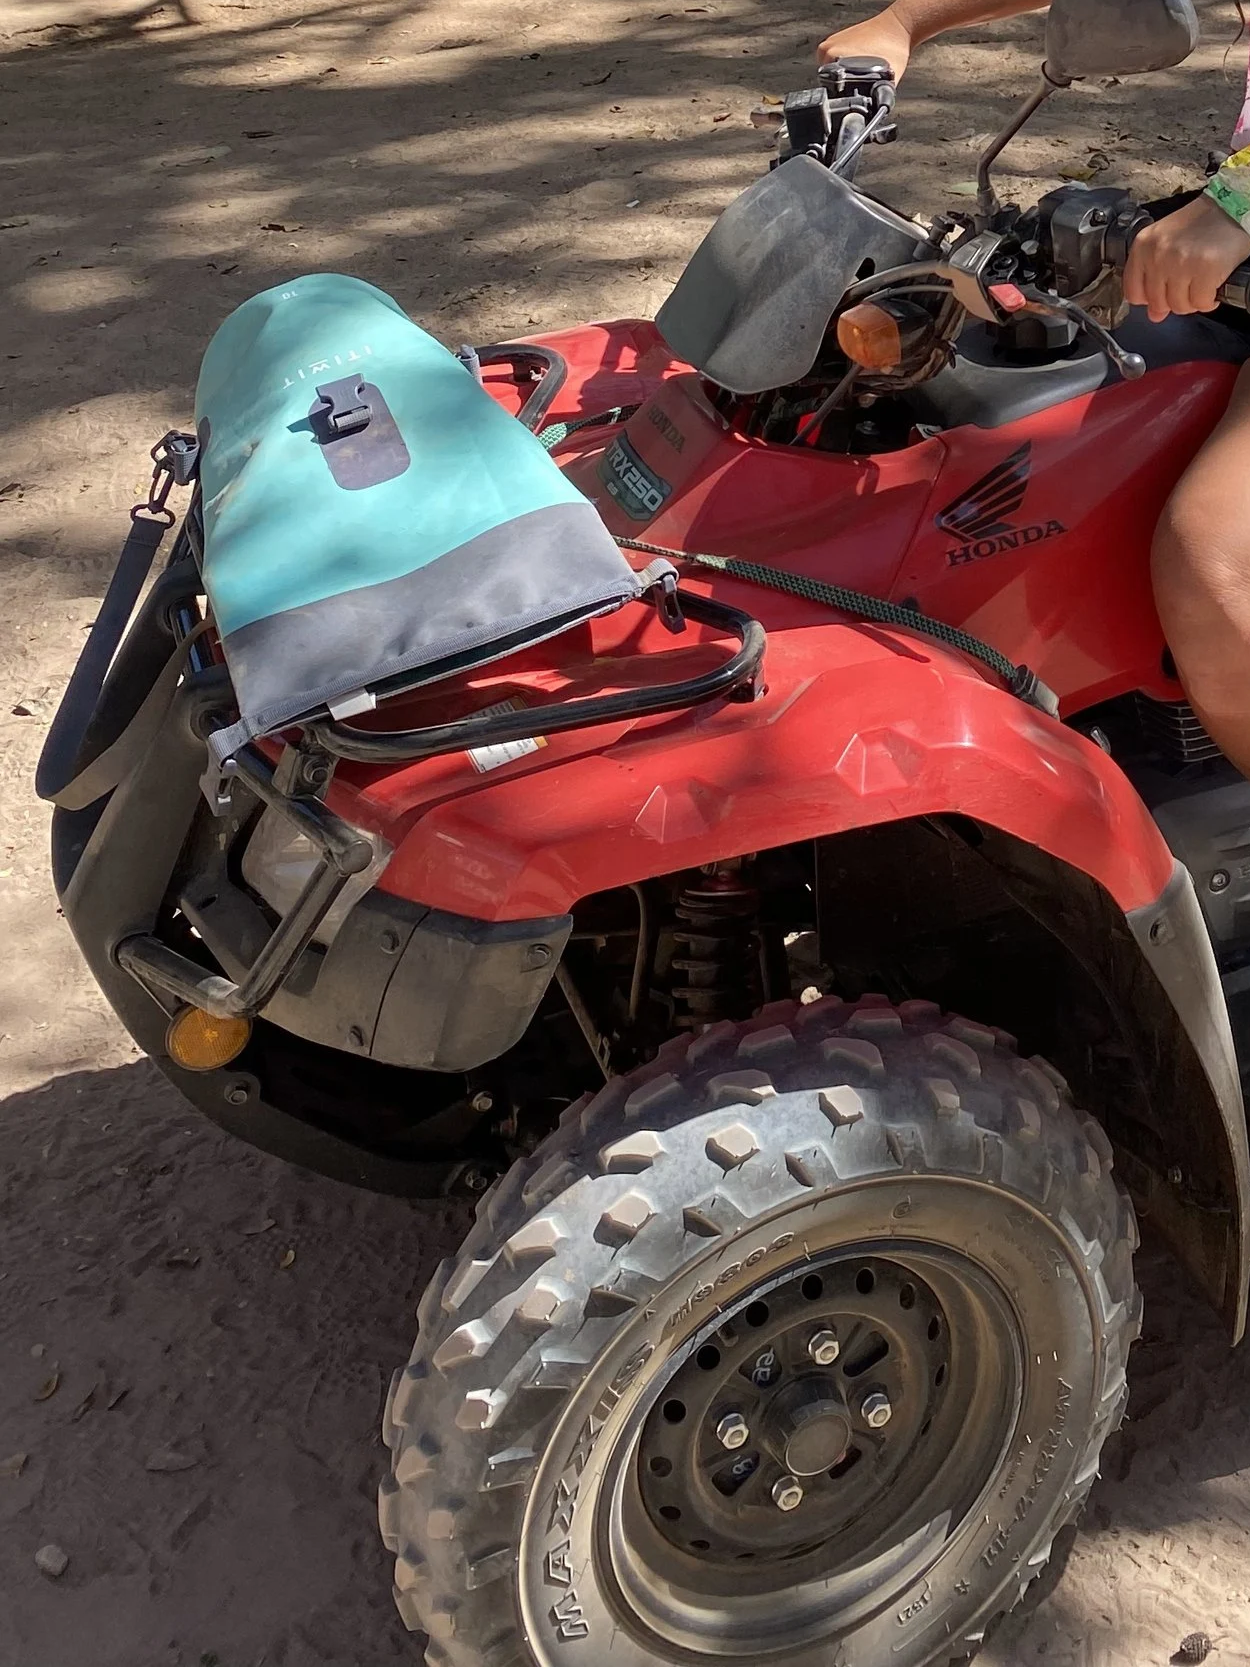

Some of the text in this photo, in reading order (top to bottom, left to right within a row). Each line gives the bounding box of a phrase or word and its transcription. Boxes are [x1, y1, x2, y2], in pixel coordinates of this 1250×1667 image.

[282, 344, 373, 391] ITIWIT
[606, 438, 664, 512] TRX250
[944, 519, 1069, 567] HONDA
[544, 1339, 656, 1641] MAXXIS
